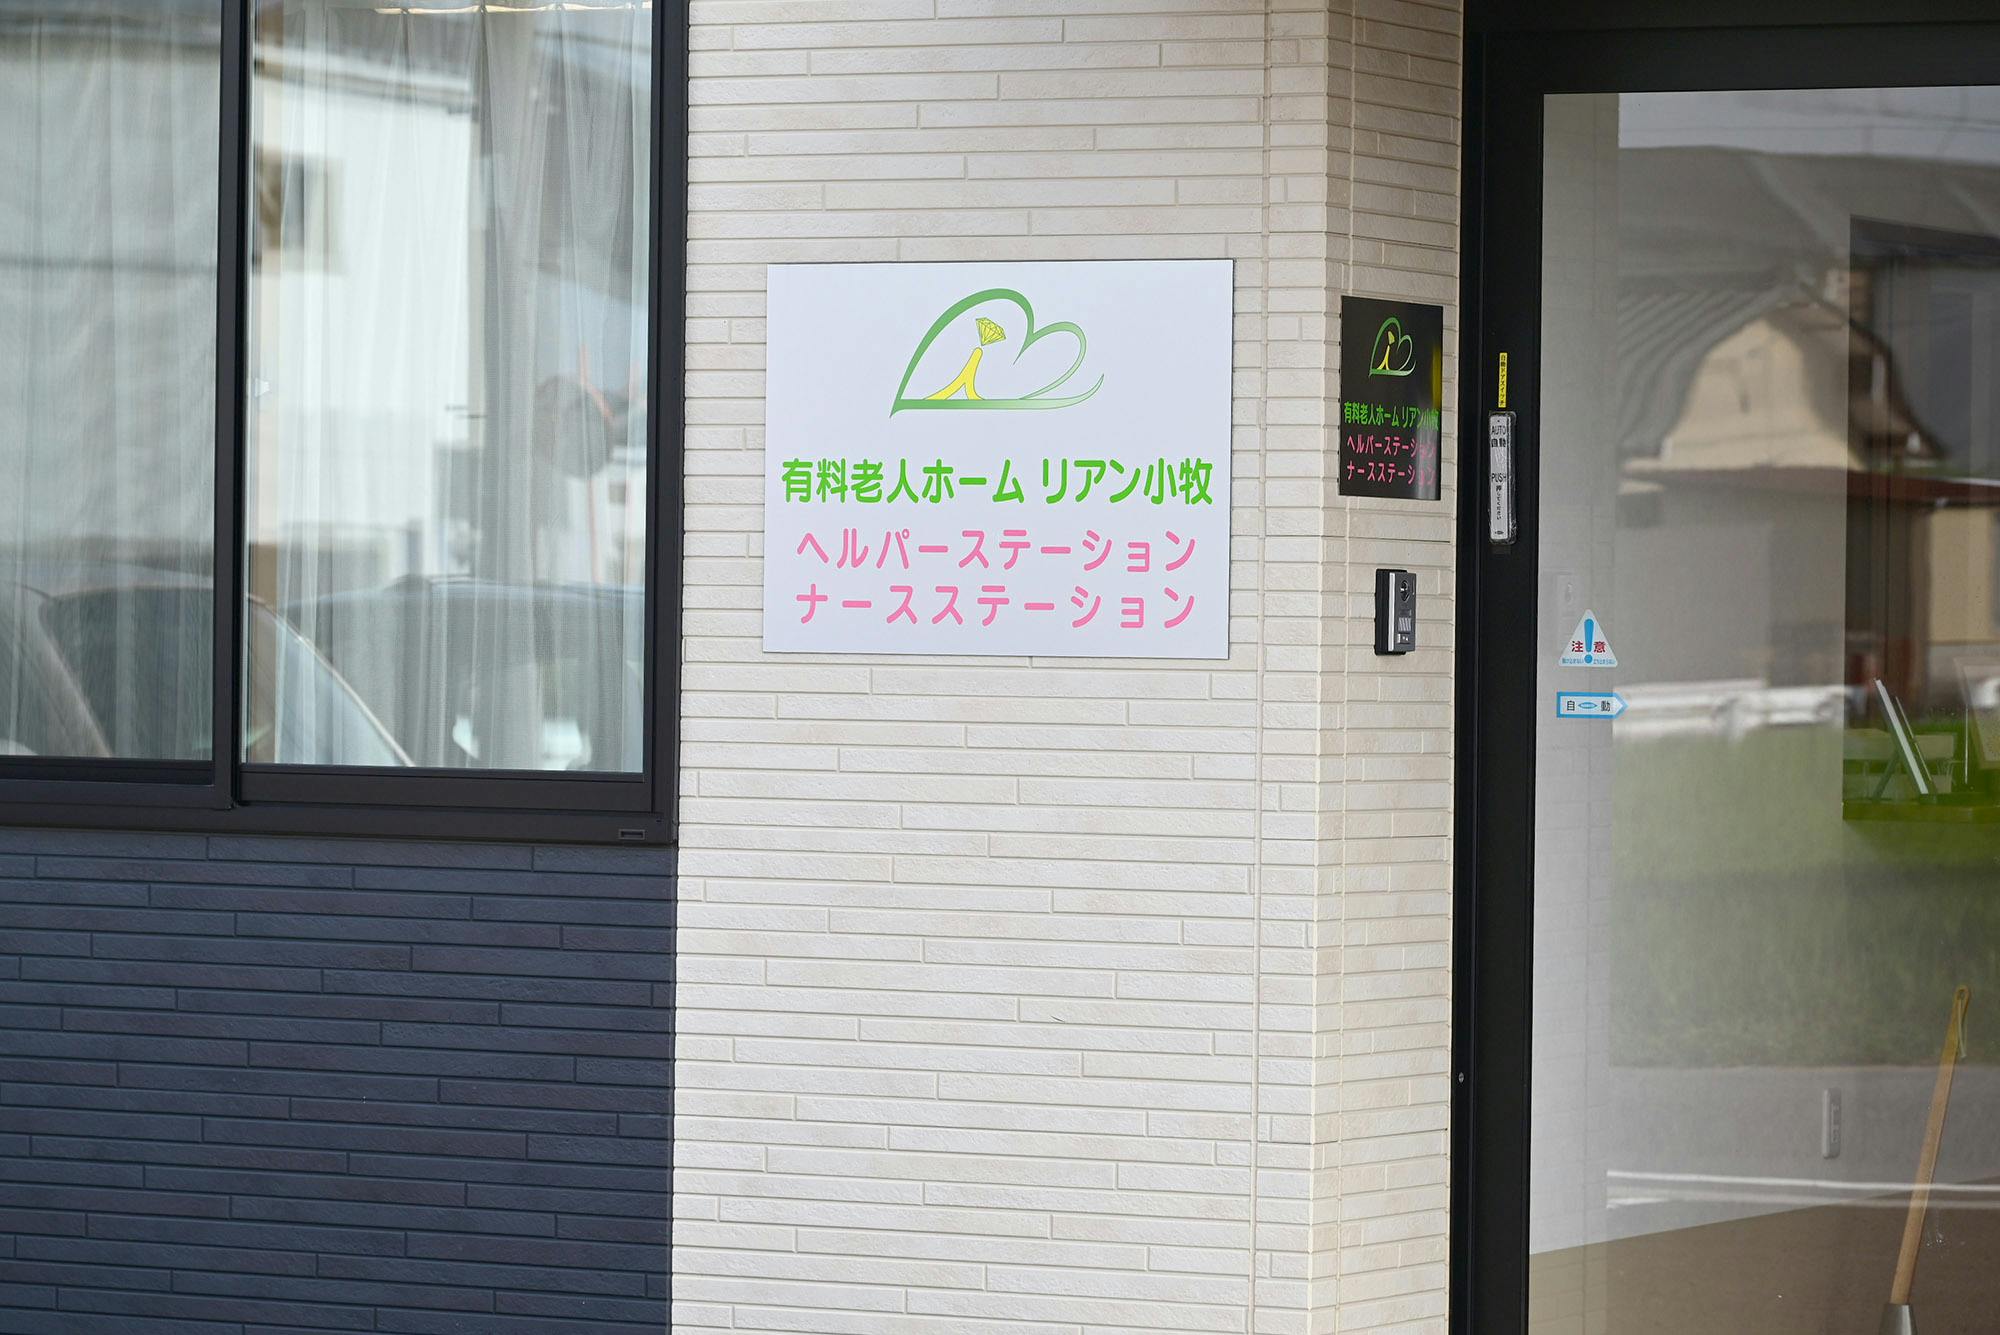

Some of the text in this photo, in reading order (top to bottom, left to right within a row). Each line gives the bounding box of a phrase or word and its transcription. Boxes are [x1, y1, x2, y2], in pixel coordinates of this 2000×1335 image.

[1344, 401, 1400, 427] 有料老人ホーム
[1492, 425, 1507, 435] AUTO
[781, 457, 1214, 506] 有料老人ホーム リアン小牧
[1491, 473, 1507, 483] PUSH
[796, 527, 1197, 573] ヘルパーステーション
[796, 582, 1196, 629] ナースステーション
